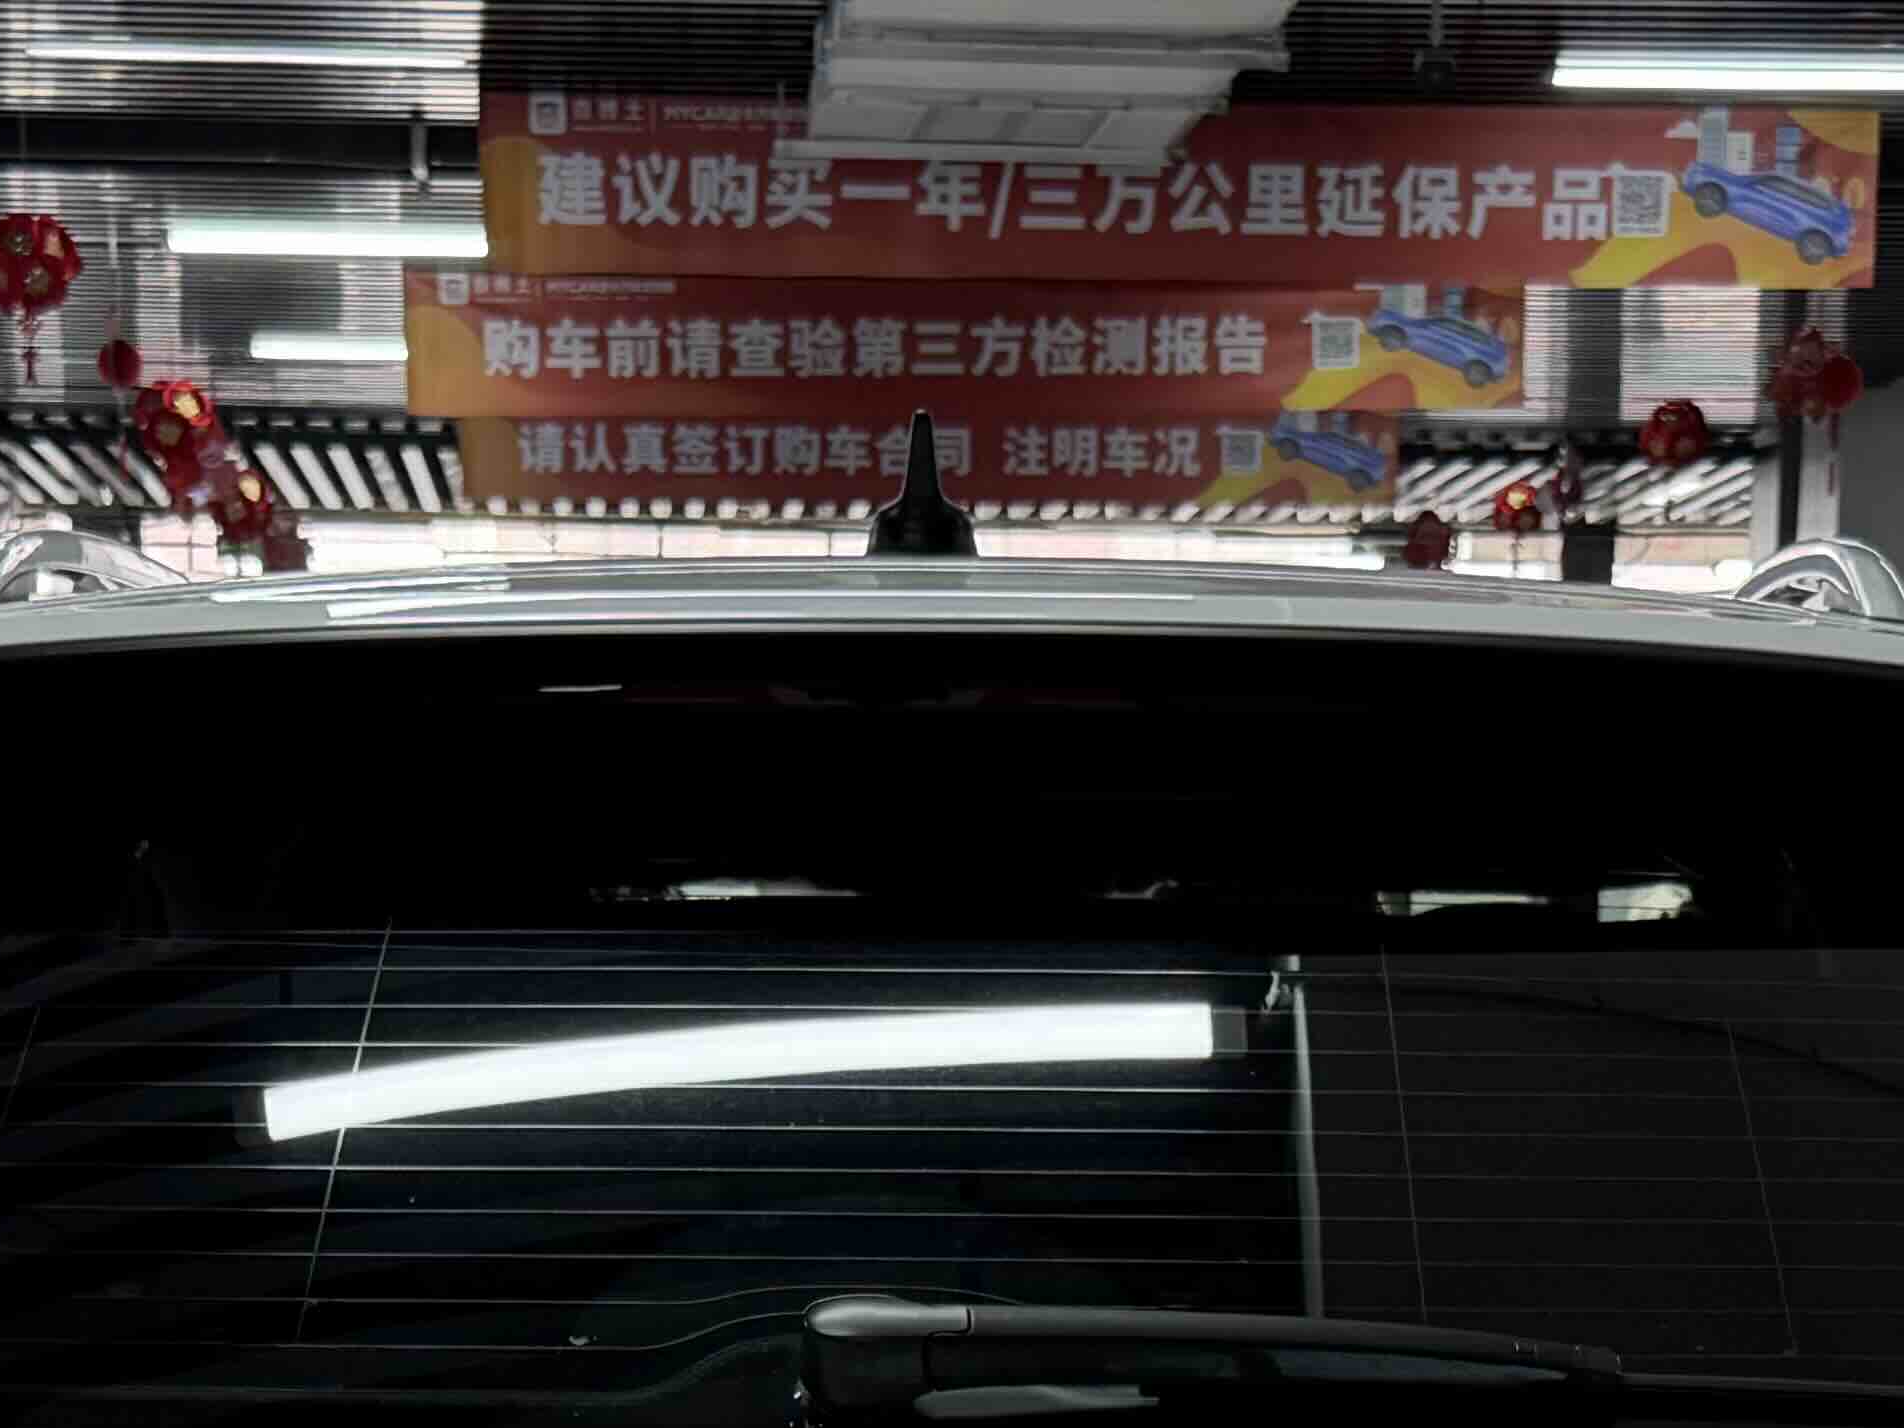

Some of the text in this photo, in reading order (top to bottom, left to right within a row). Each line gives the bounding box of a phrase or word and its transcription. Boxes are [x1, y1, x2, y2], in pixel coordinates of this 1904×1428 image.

[536, 152, 1612, 241] 建议购买一年/三万公里延保产品
[483, 317, 1267, 381] 购车前请查验第三方检测报告
[518, 421, 1201, 479] 请认真签订购车合同 注明车况
